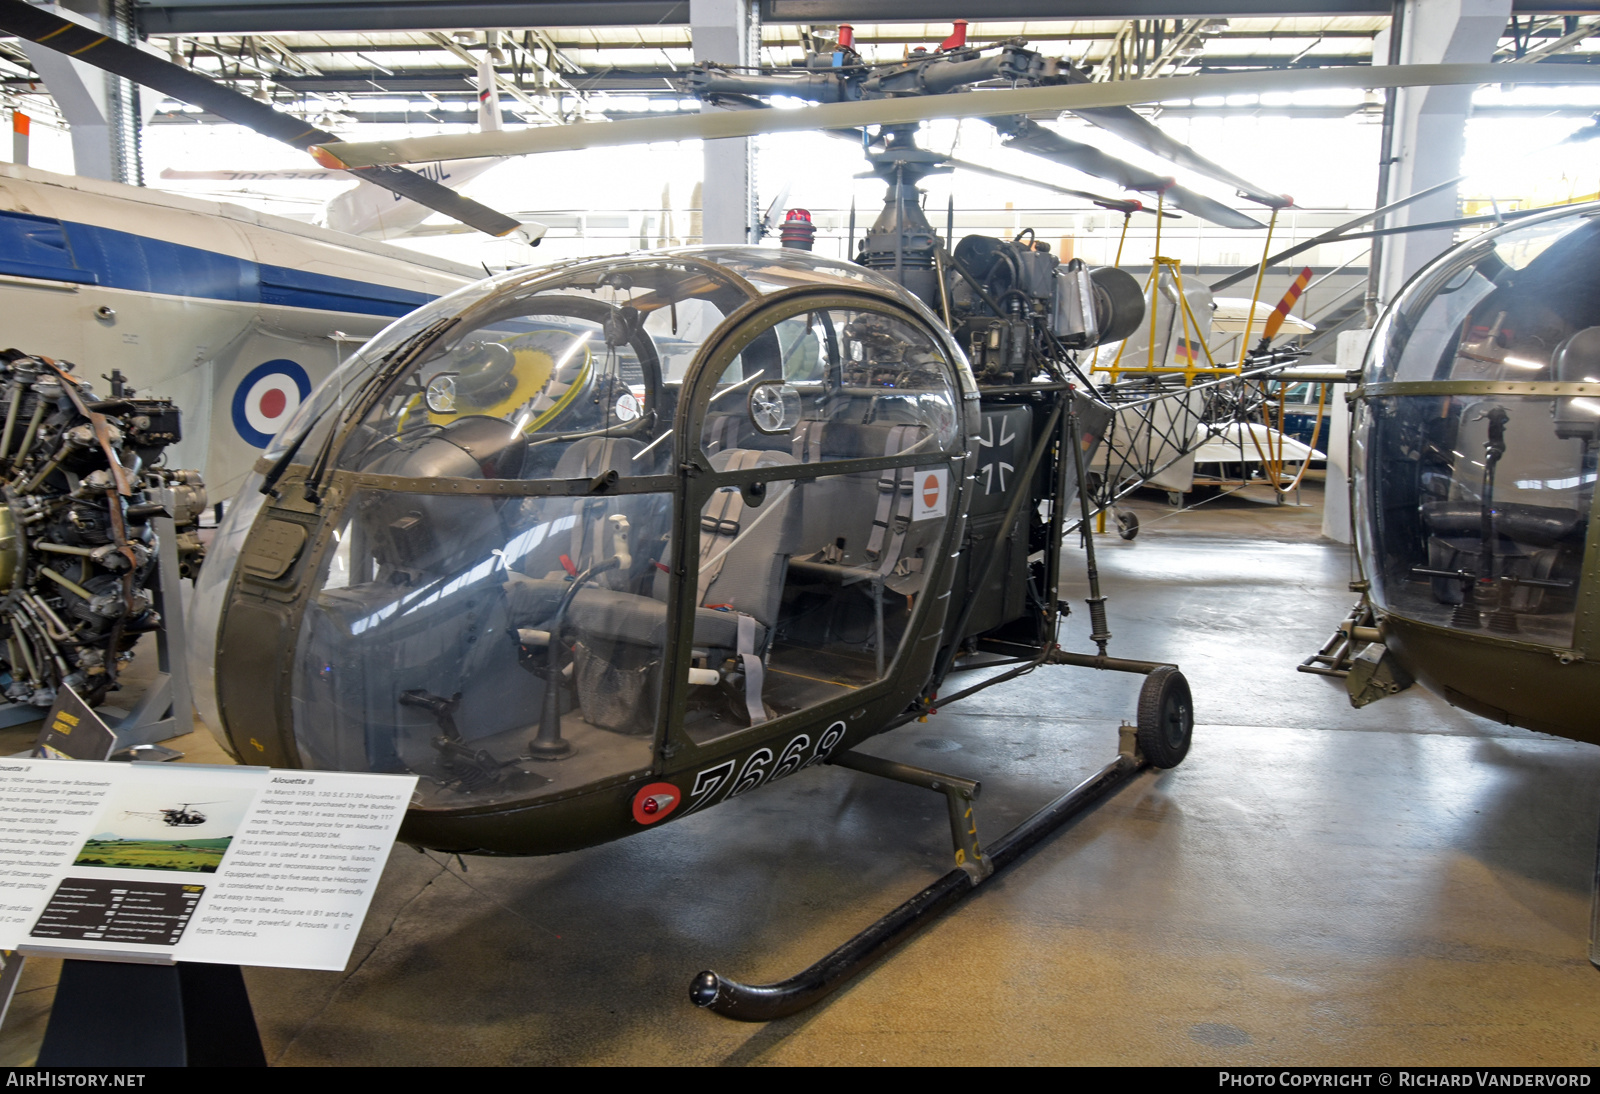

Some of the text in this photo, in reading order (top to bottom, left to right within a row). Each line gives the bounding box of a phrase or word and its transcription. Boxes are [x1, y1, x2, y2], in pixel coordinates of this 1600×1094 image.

[676, 720, 846, 820] 7668
[271, 777, 307, 785] Alouette
[289, 841, 328, 849] all-purpose
[224, 870, 256, 878] Equipped
[288, 873, 301, 881] five
[285, 886, 319, 894] extremely
[338, 888, 364, 896] friendly
[272, 908, 305, 916] Artouste
[201, 916, 228, 924] slightly
[296, 921, 328, 929] Artouste
[343, 923, 351, 931] C
